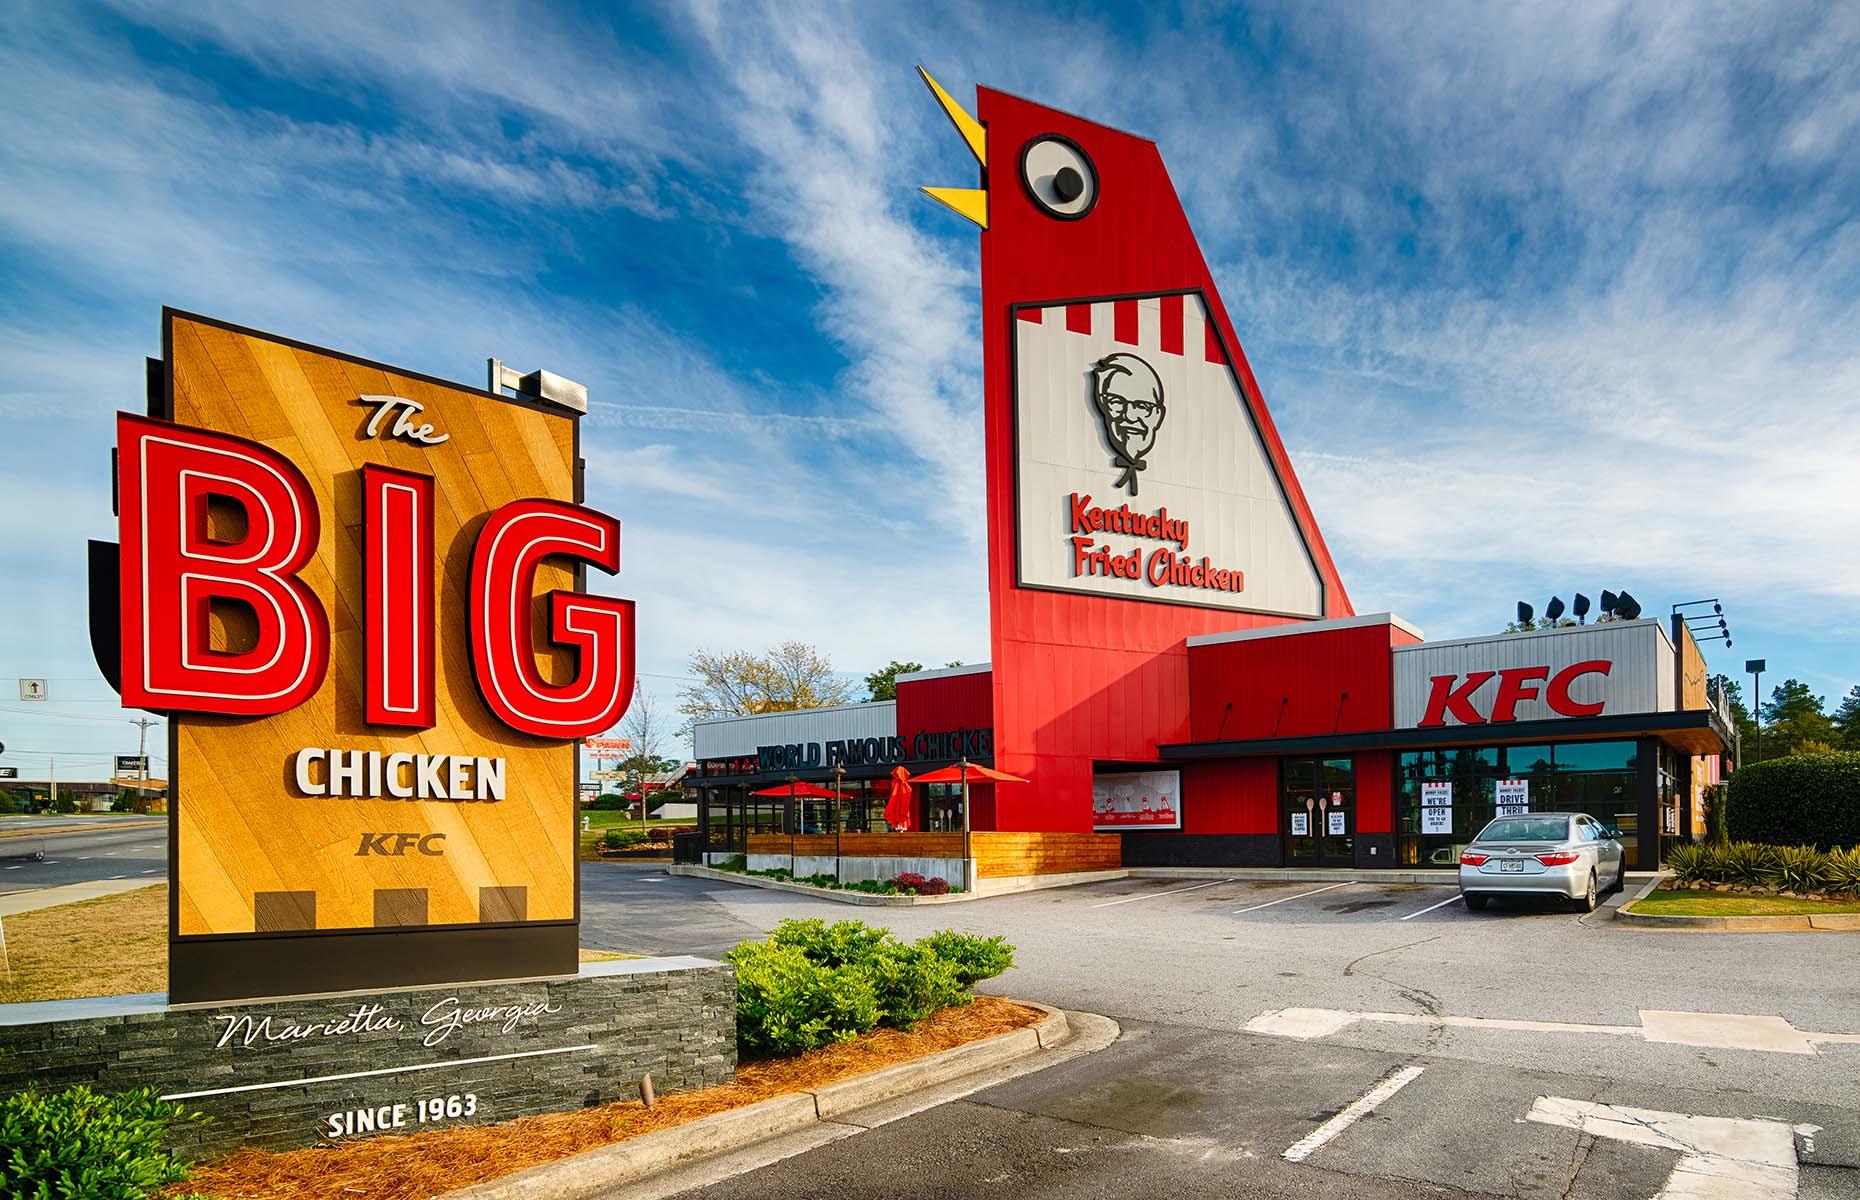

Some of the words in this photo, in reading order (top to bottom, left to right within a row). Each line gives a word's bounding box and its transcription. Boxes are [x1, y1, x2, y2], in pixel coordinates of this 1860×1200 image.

[361, 394, 449, 445] The
[1070, 492, 1190, 551] Kentucky
[117, 411, 636, 738] BIG
[1071, 536, 1142, 580] Fried
[1148, 547, 1245, 593] Chicken
[1417, 659, 1613, 728] KFC
[757, 744, 821, 770] WORLD
[825, 735, 907, 767] FAMOUS
[914, 728, 993, 761] CHICKE
[296, 747, 507, 800] CHICKEN
[1427, 797, 1447, 805] WE'RE
[1428, 808, 1446, 816] OPEN
[1500, 795, 1525, 804] DRIVE
[1501, 806, 1523, 815] THRU
[354, 833, 447, 857] KFC
[215, 1003, 404, 1048] Marietta,
[420, 997, 562, 1047] Georgia
[328, 1103, 407, 1138] SINCE
[418, 1093, 477, 1126] 1963
